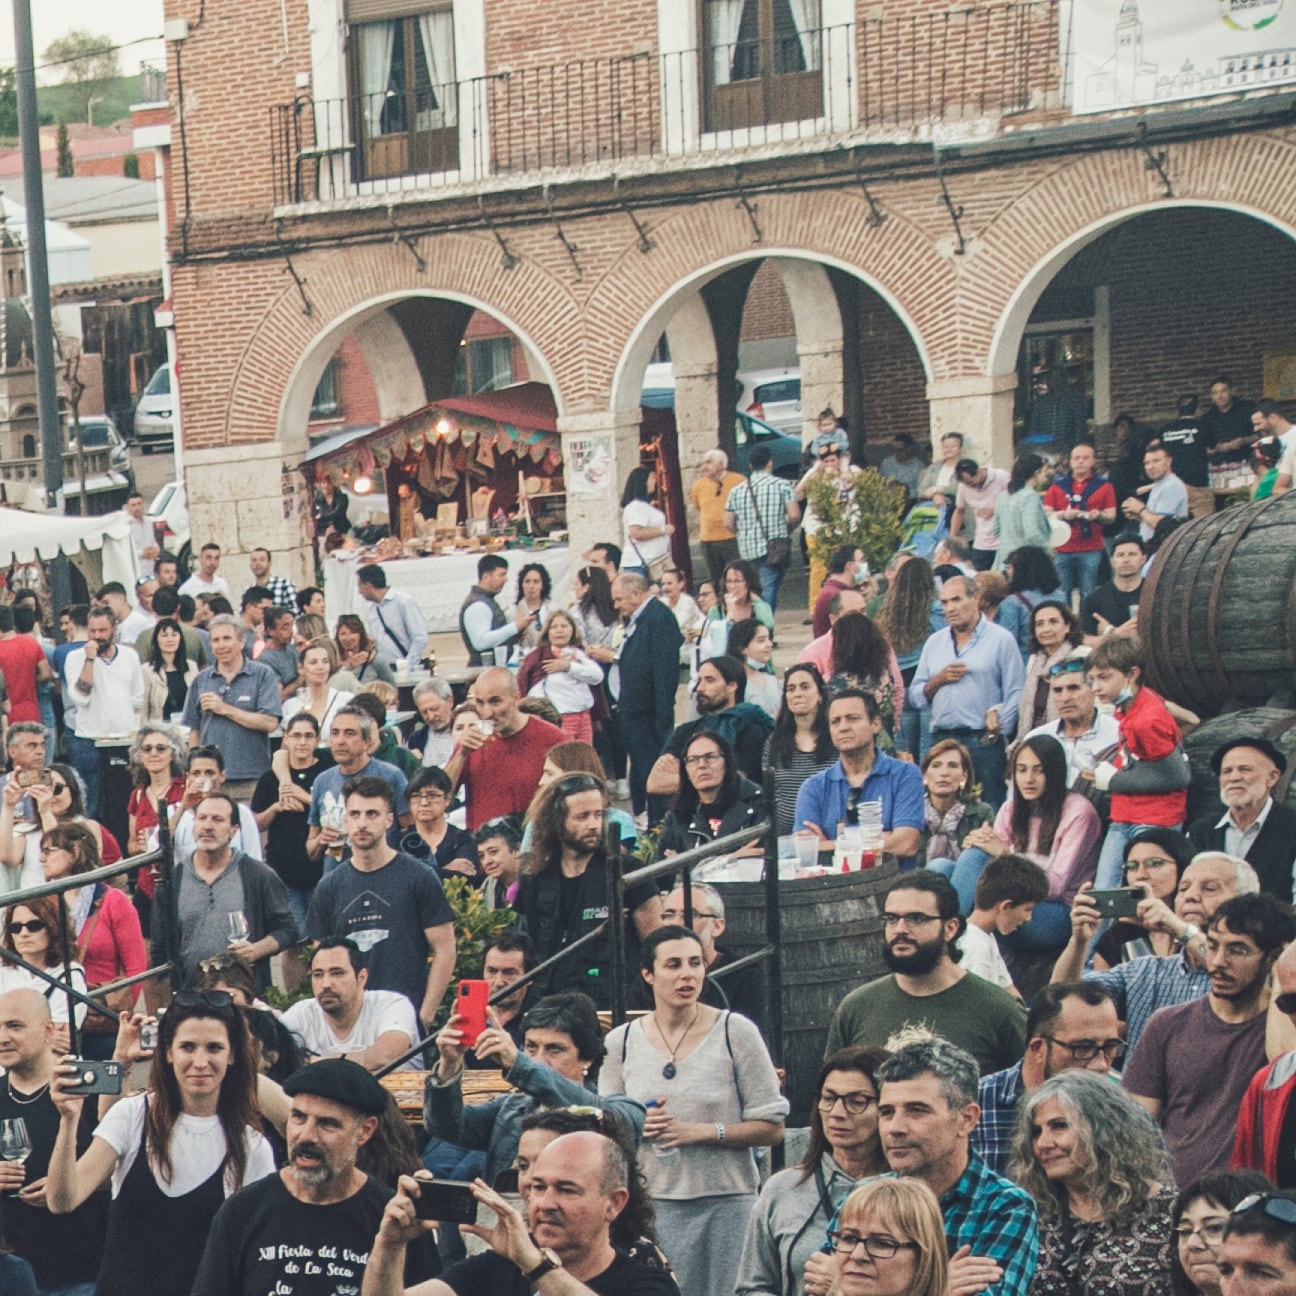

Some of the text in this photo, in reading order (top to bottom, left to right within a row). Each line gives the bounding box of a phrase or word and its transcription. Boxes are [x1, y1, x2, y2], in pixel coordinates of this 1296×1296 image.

[318, 1245, 338, 1259] del
[342, 1249, 368, 1264] Verd
[284, 1261, 354, 1278] de La Seca
